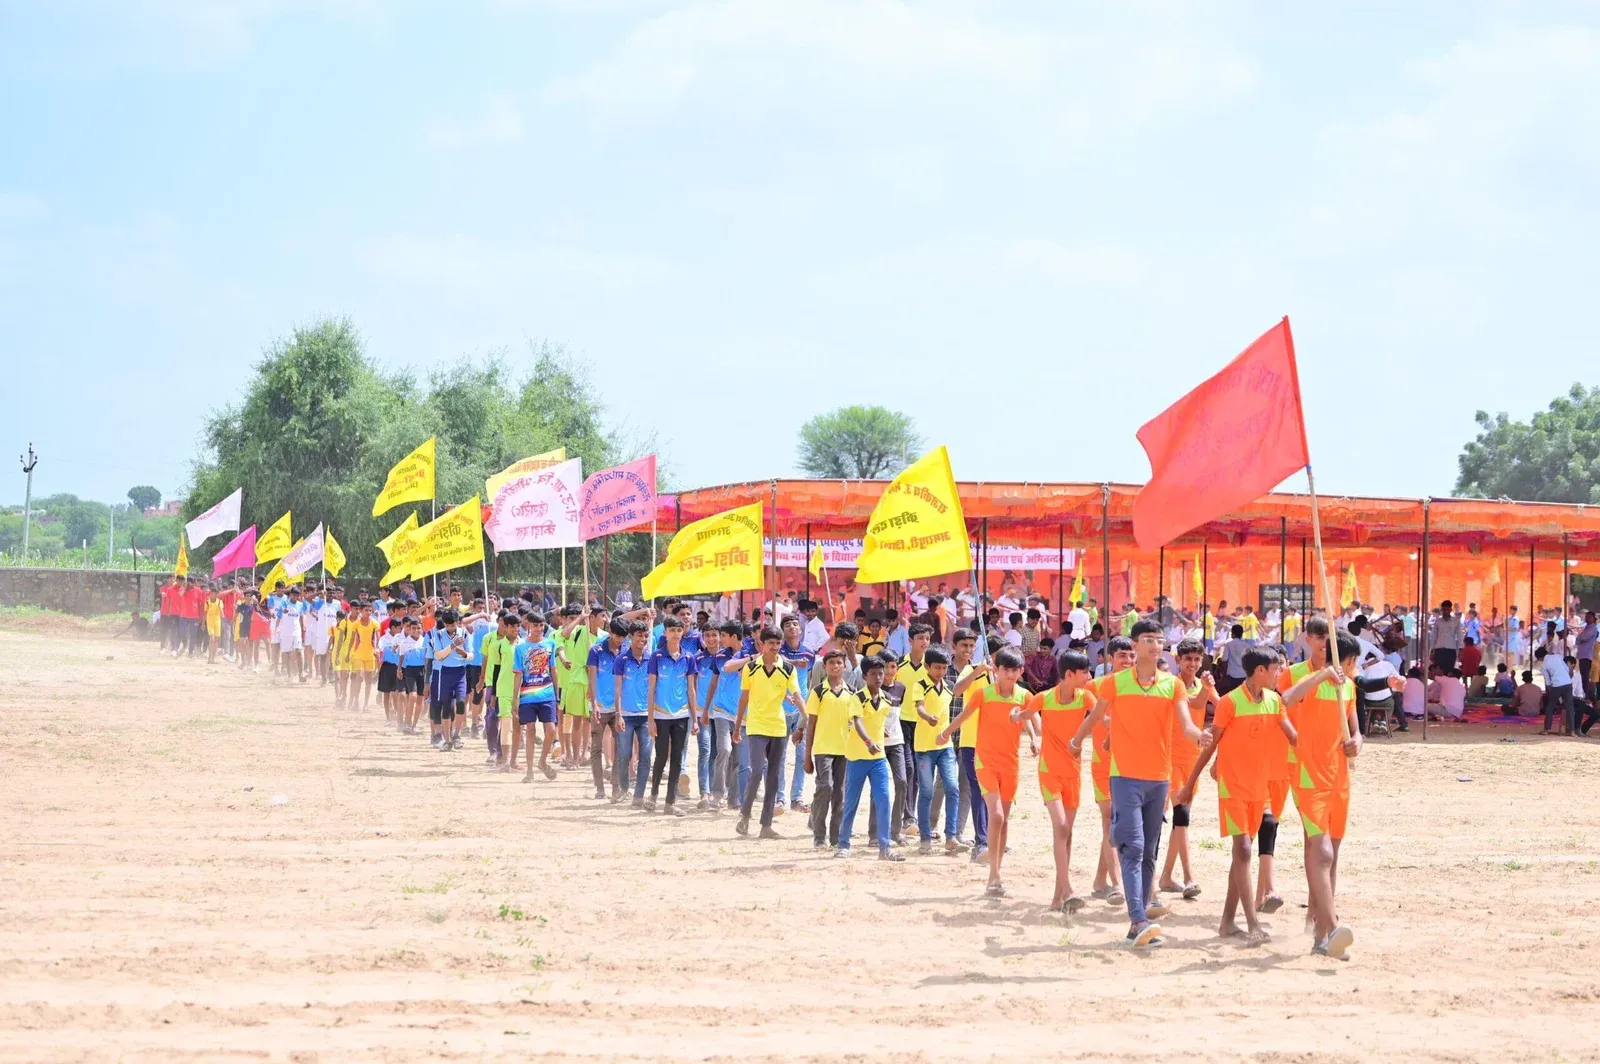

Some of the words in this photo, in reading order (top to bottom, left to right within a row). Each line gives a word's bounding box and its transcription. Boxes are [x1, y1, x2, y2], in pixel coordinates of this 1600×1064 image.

[790, 537, 816, 546] स्तरय
[820, 539, 854, 551] खलकूद
[832, 550, 860, 562] विद्याल
